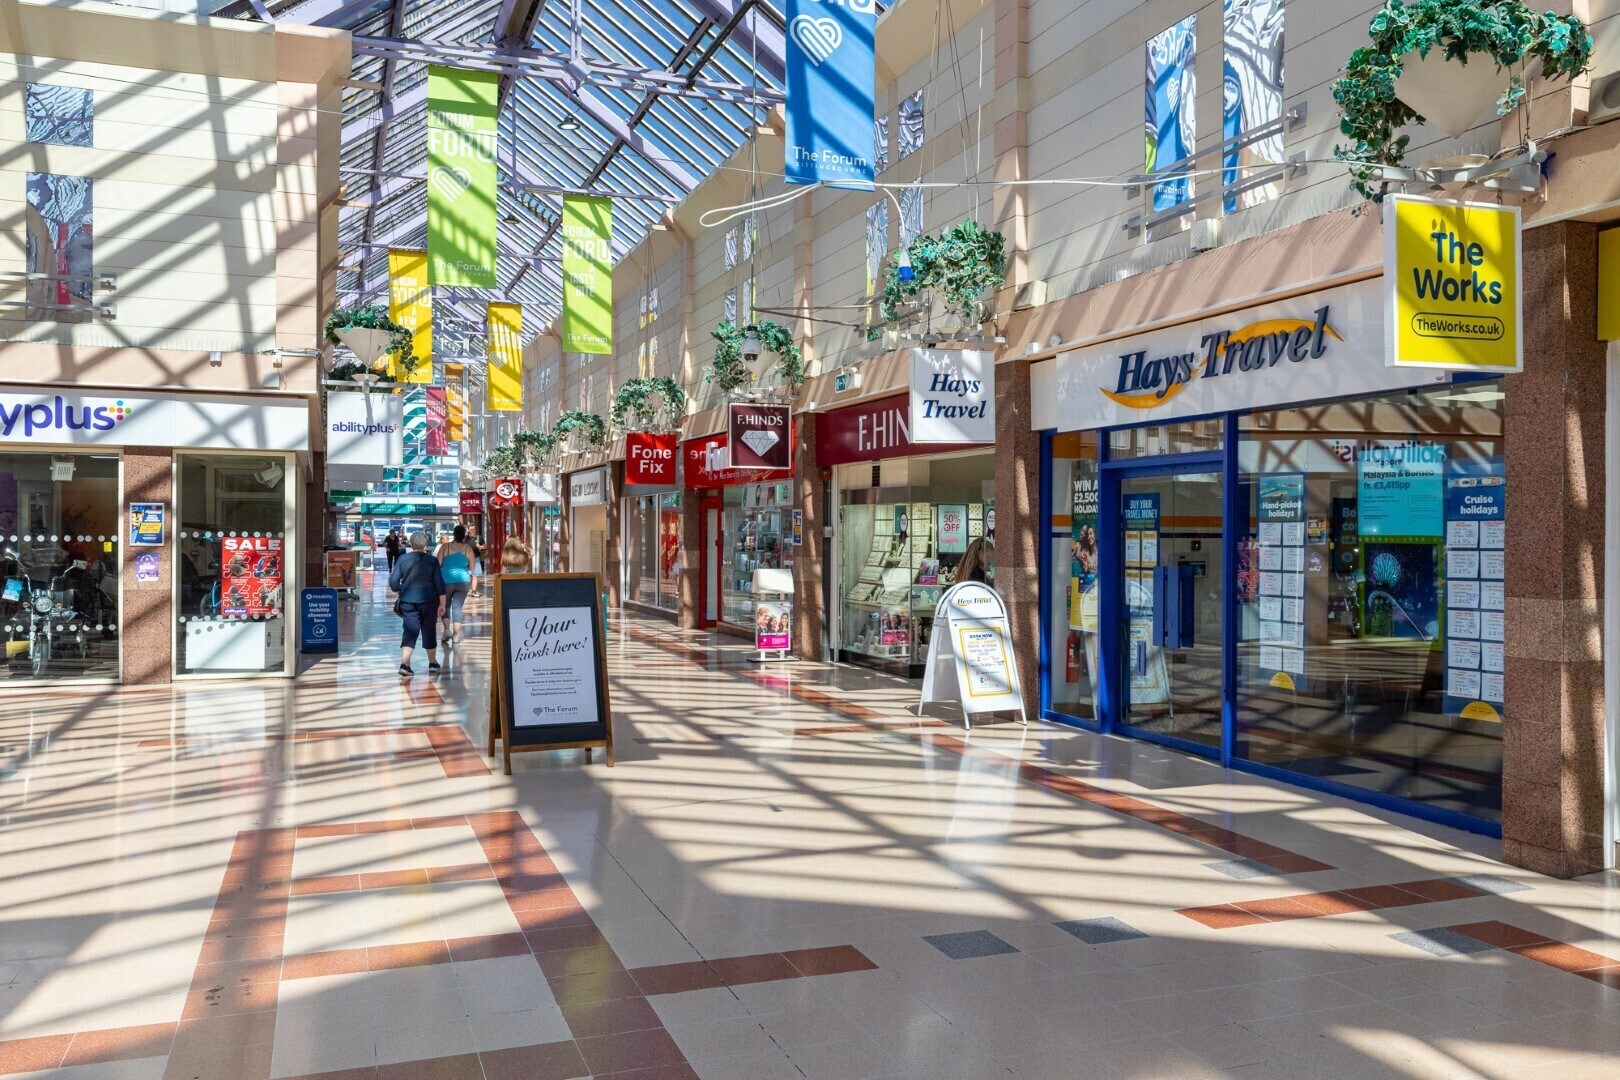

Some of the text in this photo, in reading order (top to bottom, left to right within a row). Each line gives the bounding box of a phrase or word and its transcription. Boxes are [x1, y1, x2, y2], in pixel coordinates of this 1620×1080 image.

[430, 109, 475, 129] FORUM
[792, 146, 867, 167] The Forum
[563, 224, 595, 239] FORUM
[1432, 231, 1484, 267] The
[432, 258, 453, 270] The
[456, 260, 491, 273] Forum
[1412, 267, 1503, 306] Works
[1416, 318, 1500, 336] TheWorks.co.uk
[583, 333, 608, 344] Forum
[1114, 305, 1330, 399] Hays Travel
[929, 373, 981, 398] Hays
[0, 395, 116, 437] yplus
[922, 399, 987, 419] Travel
[737, 414, 783, 426] F.HINDS
[332, 421, 395, 436] abilityplus
[631, 444, 673, 460] Fone
[639, 459, 664, 474] Fix
[1363, 468, 1435, 480] Malaysia & Borneo
[572, 483, 584, 498] NEW
[1073, 480, 1092, 492] WIN
[1363, 482, 1373, 491] fr.
[1130, 499, 1153, 510] BUY YOUR
[1262, 501, 1303, 512] Hand-picked
[1464, 495, 1494, 505] Cruise
[1124, 508, 1158, 519] TRAVEL MONEY
[1268, 509, 1295, 519] holidays
[1460, 505, 1499, 516] holidays
[943, 514, 961, 524] 50%
[943, 523, 960, 532] OFF
[224, 538, 281, 551] SALE
[524, 616, 577, 647] Your
[514, 636, 588, 663] kiosk here!
